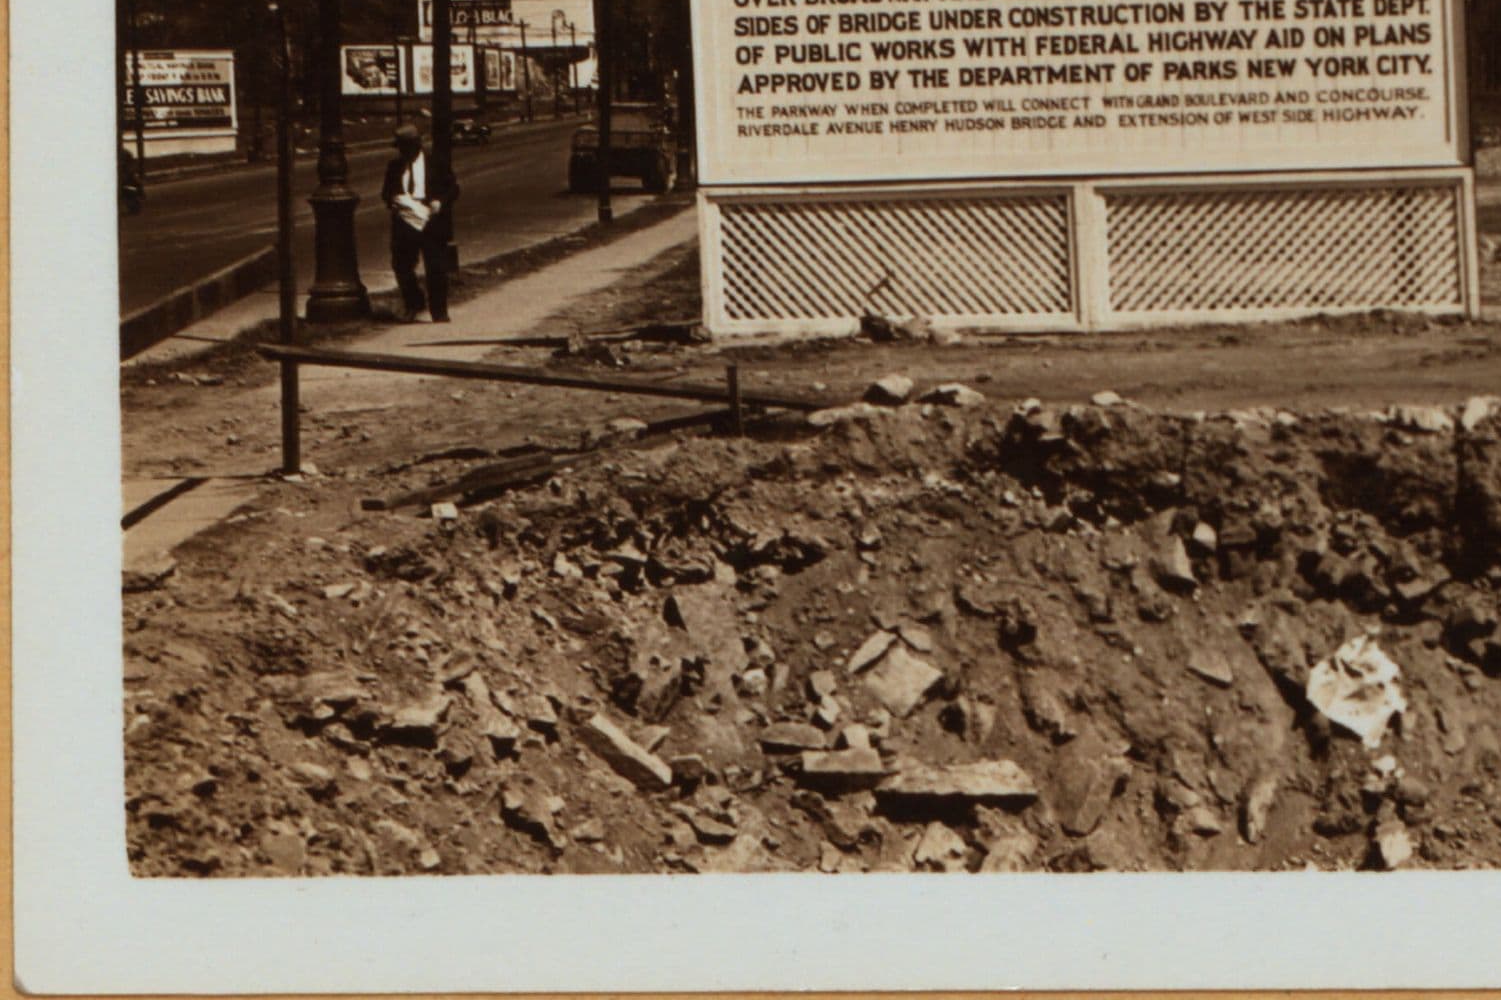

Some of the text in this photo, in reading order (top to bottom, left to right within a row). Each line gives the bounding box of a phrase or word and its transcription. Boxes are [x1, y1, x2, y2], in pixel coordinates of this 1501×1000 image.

[734, 16, 798, 36] SIDES
[806, 14, 831, 34] OF
[838, 11, 921, 34] BRIDGE
[929, 8, 1002, 30] UNDER
[1008, 3, 1184, 28] CONSTRUCTION
[1194, 1, 1227, 22] BY
[1238, 0, 1286, 20] THE
[735, 23, 1432, 65] OF PUBLIC WORKS WITH FEDERAL HIGHWAY AID ON PLANS
[737, 54, 1432, 95] APPROVED BY THE DEPARTMENT OF PARKS NEW YORK CITY.
[145, 87, 195, 104] SAVINGS
[197, 87, 226, 103] BANK
[737, 106, 763, 119] THE
[772, 104, 836, 118] PARKWAY
[844, 102, 888, 116] WHEN
[895, 100, 977, 115] COMPLETED
[984, 99, 1016, 112] WILL
[1021, 96, 1090, 111] CONNECT
[1102, 94, 1134, 109] WITH
[1136, 93, 1180, 108] GRAND
[1185, 91, 1270, 107] BOULEVARD
[1274, 89, 1309, 104] AND
[737, 122, 819, 137] RIVERDALE
[826, 121, 883, 135] AVENUE
[889, 120, 938, 134] HENRY
[945, 117, 1004, 132] HUDSON
[1011, 116, 1067, 130] BRIDGE
[1073, 114, 1106, 128] AND
[1118, 112, 1209, 127] EXTENSION
[1213, 111, 1233, 125] OF
[1238, 110, 1276, 124] WEST
[1283, 109, 1316, 123] SIDE
